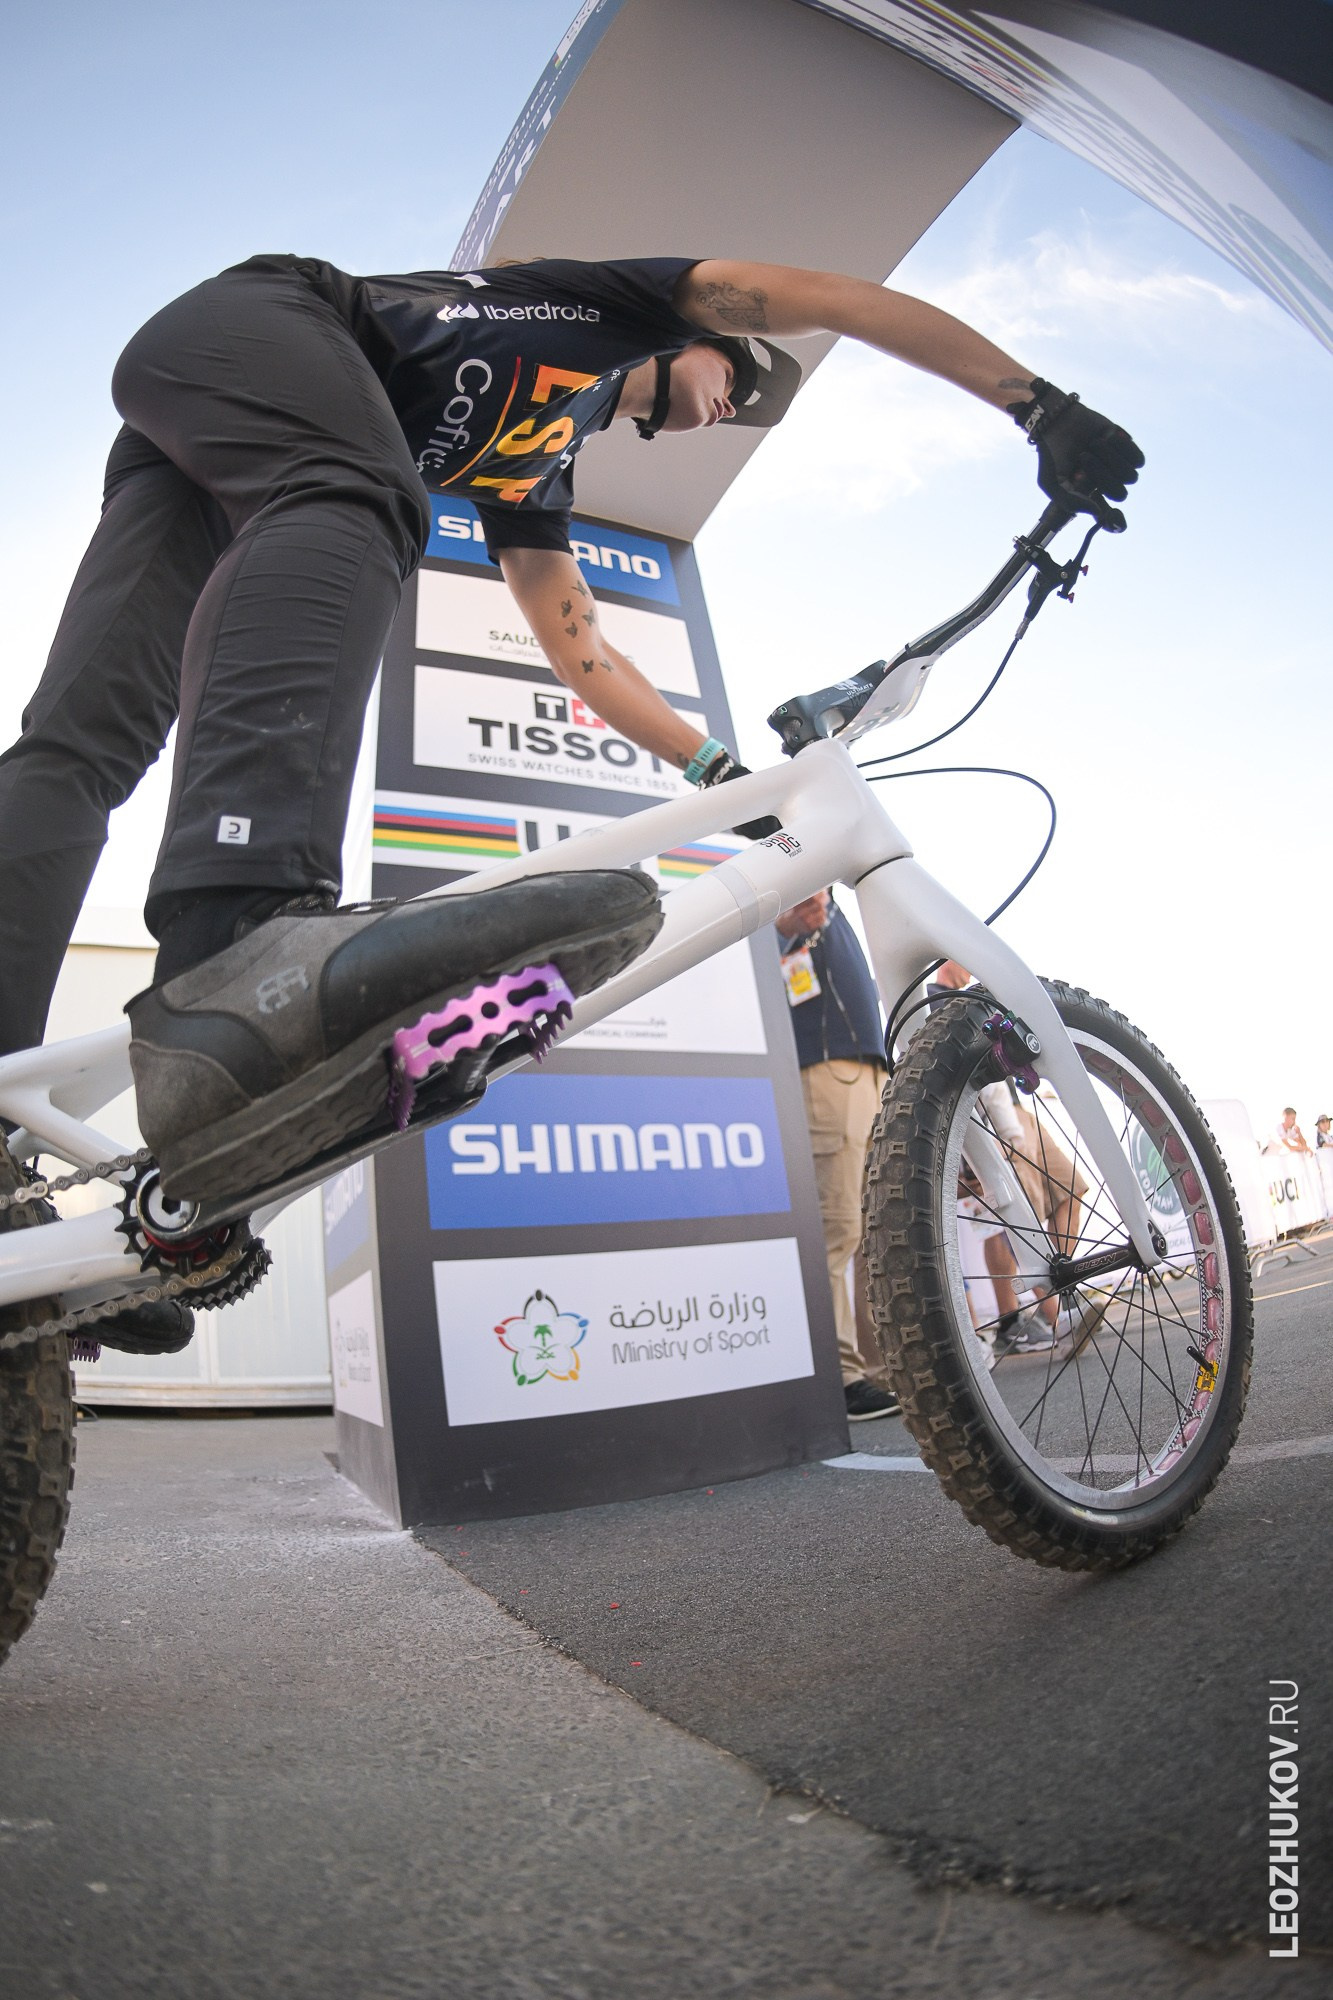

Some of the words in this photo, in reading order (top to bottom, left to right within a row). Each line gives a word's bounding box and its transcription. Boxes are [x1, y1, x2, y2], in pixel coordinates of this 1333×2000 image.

[482, 302, 601, 323] Iberdrola
[437, 514, 662, 581] SANO
[468, 753, 517, 769] SWISS
[521, 759, 594, 780] WATCHES
[598, 771, 642, 787] SINCE
[646, 779, 679, 793] 1853
[448, 1122, 765, 1175] SHIMANO
[1273, 1177, 1300, 1205] UCI
[609, 1296, 700, 1332] الرياضة
[708, 1291, 767, 1325] وزارة
[611, 1337, 689, 1365] Ministry
[693, 1331, 713, 1354] of
[717, 1324, 771, 1354] Sport
